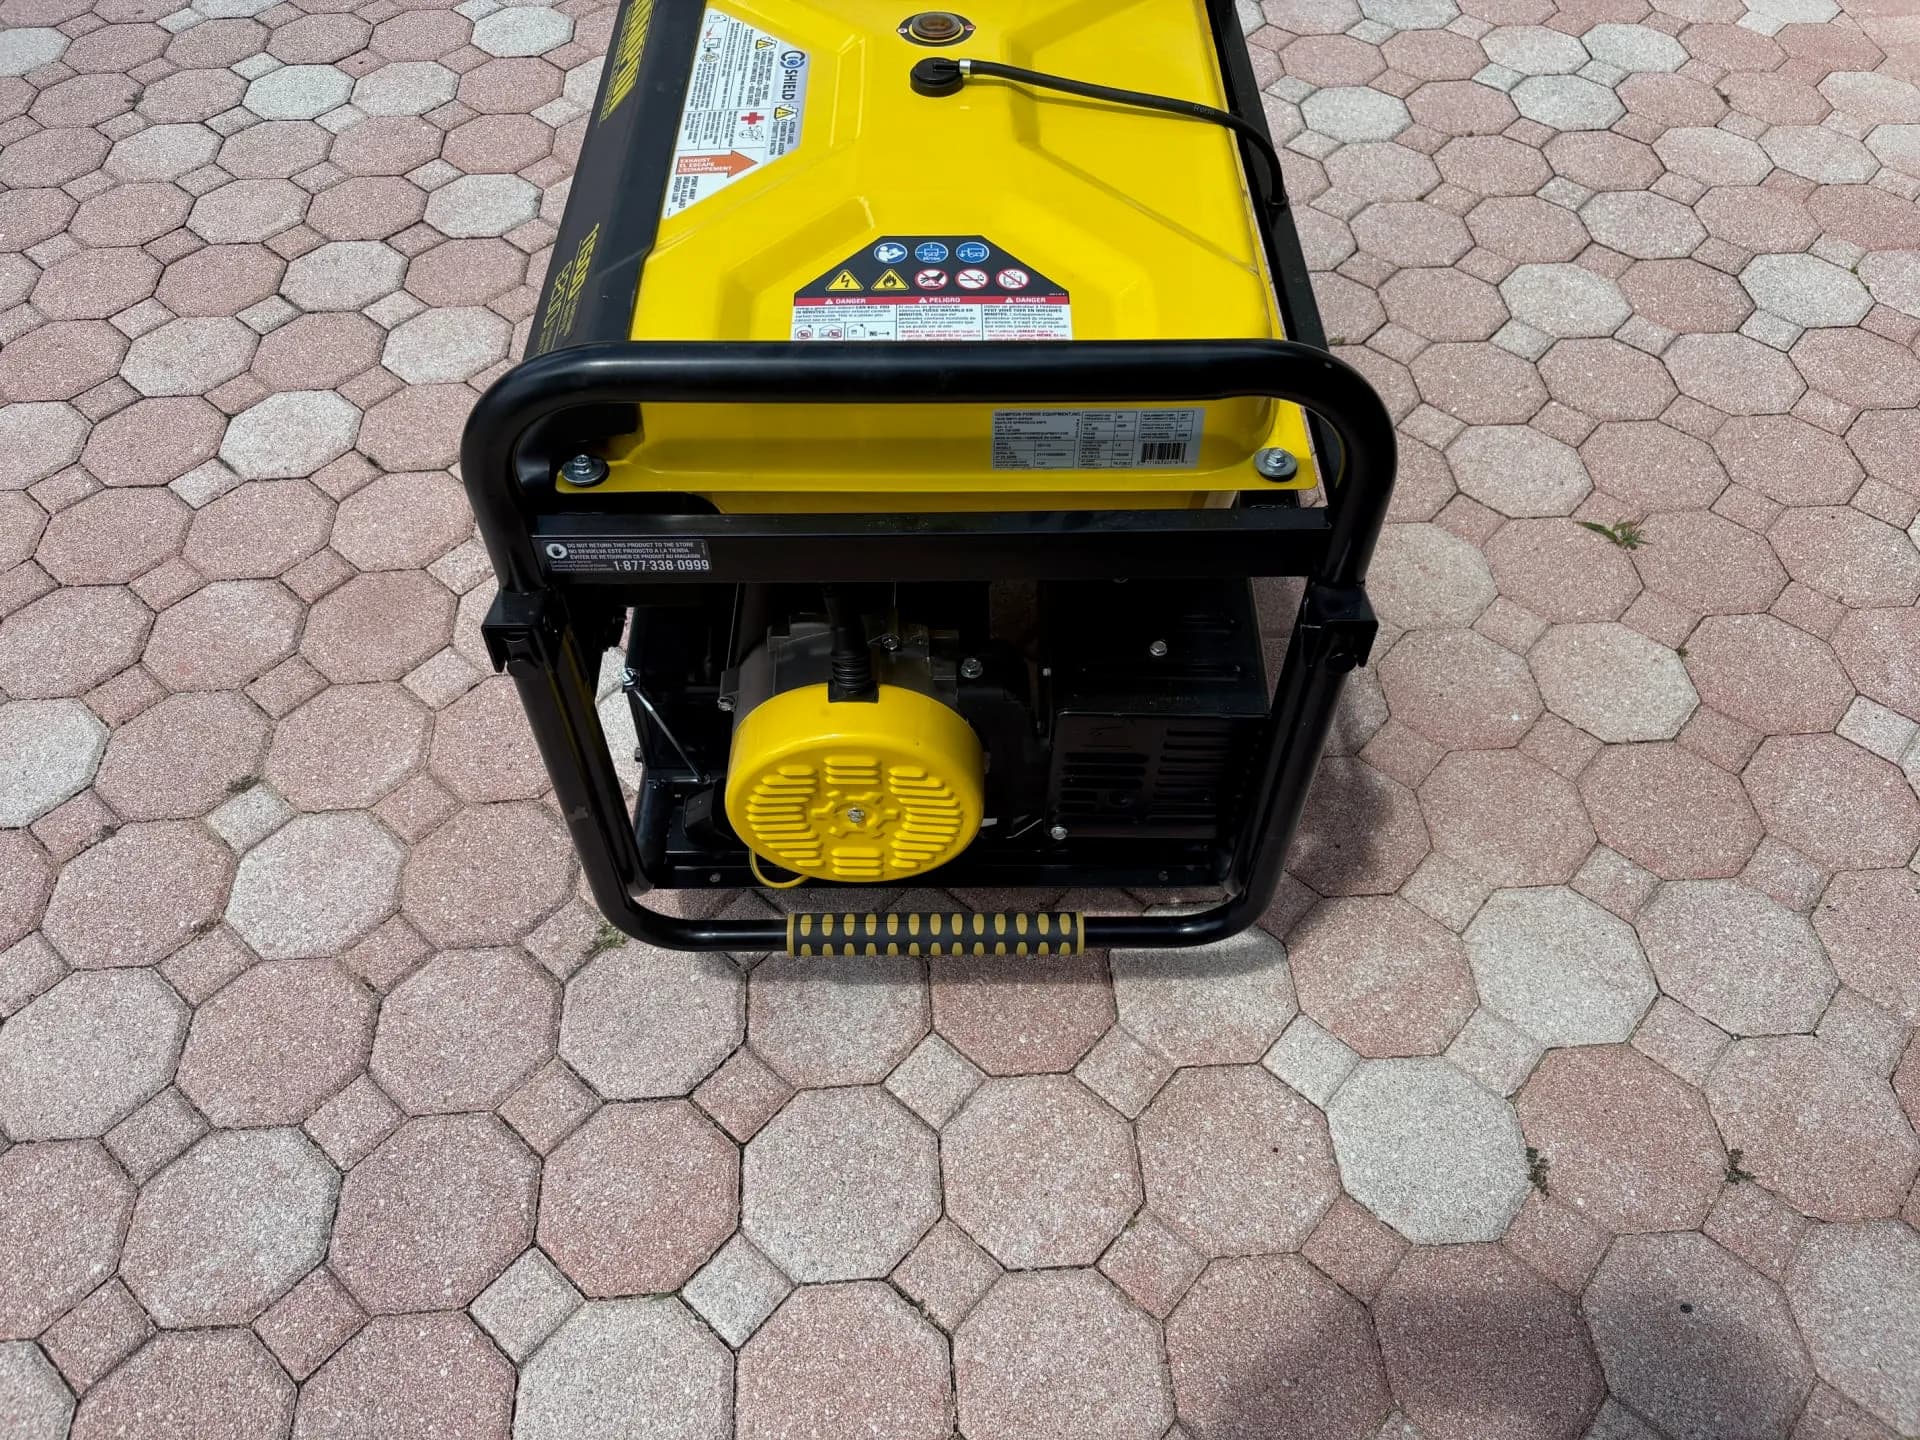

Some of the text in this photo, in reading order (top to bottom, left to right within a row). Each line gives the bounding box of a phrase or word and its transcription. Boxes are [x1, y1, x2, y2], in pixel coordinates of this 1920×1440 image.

[782, 69, 798, 100] SHIELD
[568, 223, 600, 300] 11500
[544, 260, 572, 328] 9200
[614, 560, 709, 571] 1-877-338-0999
